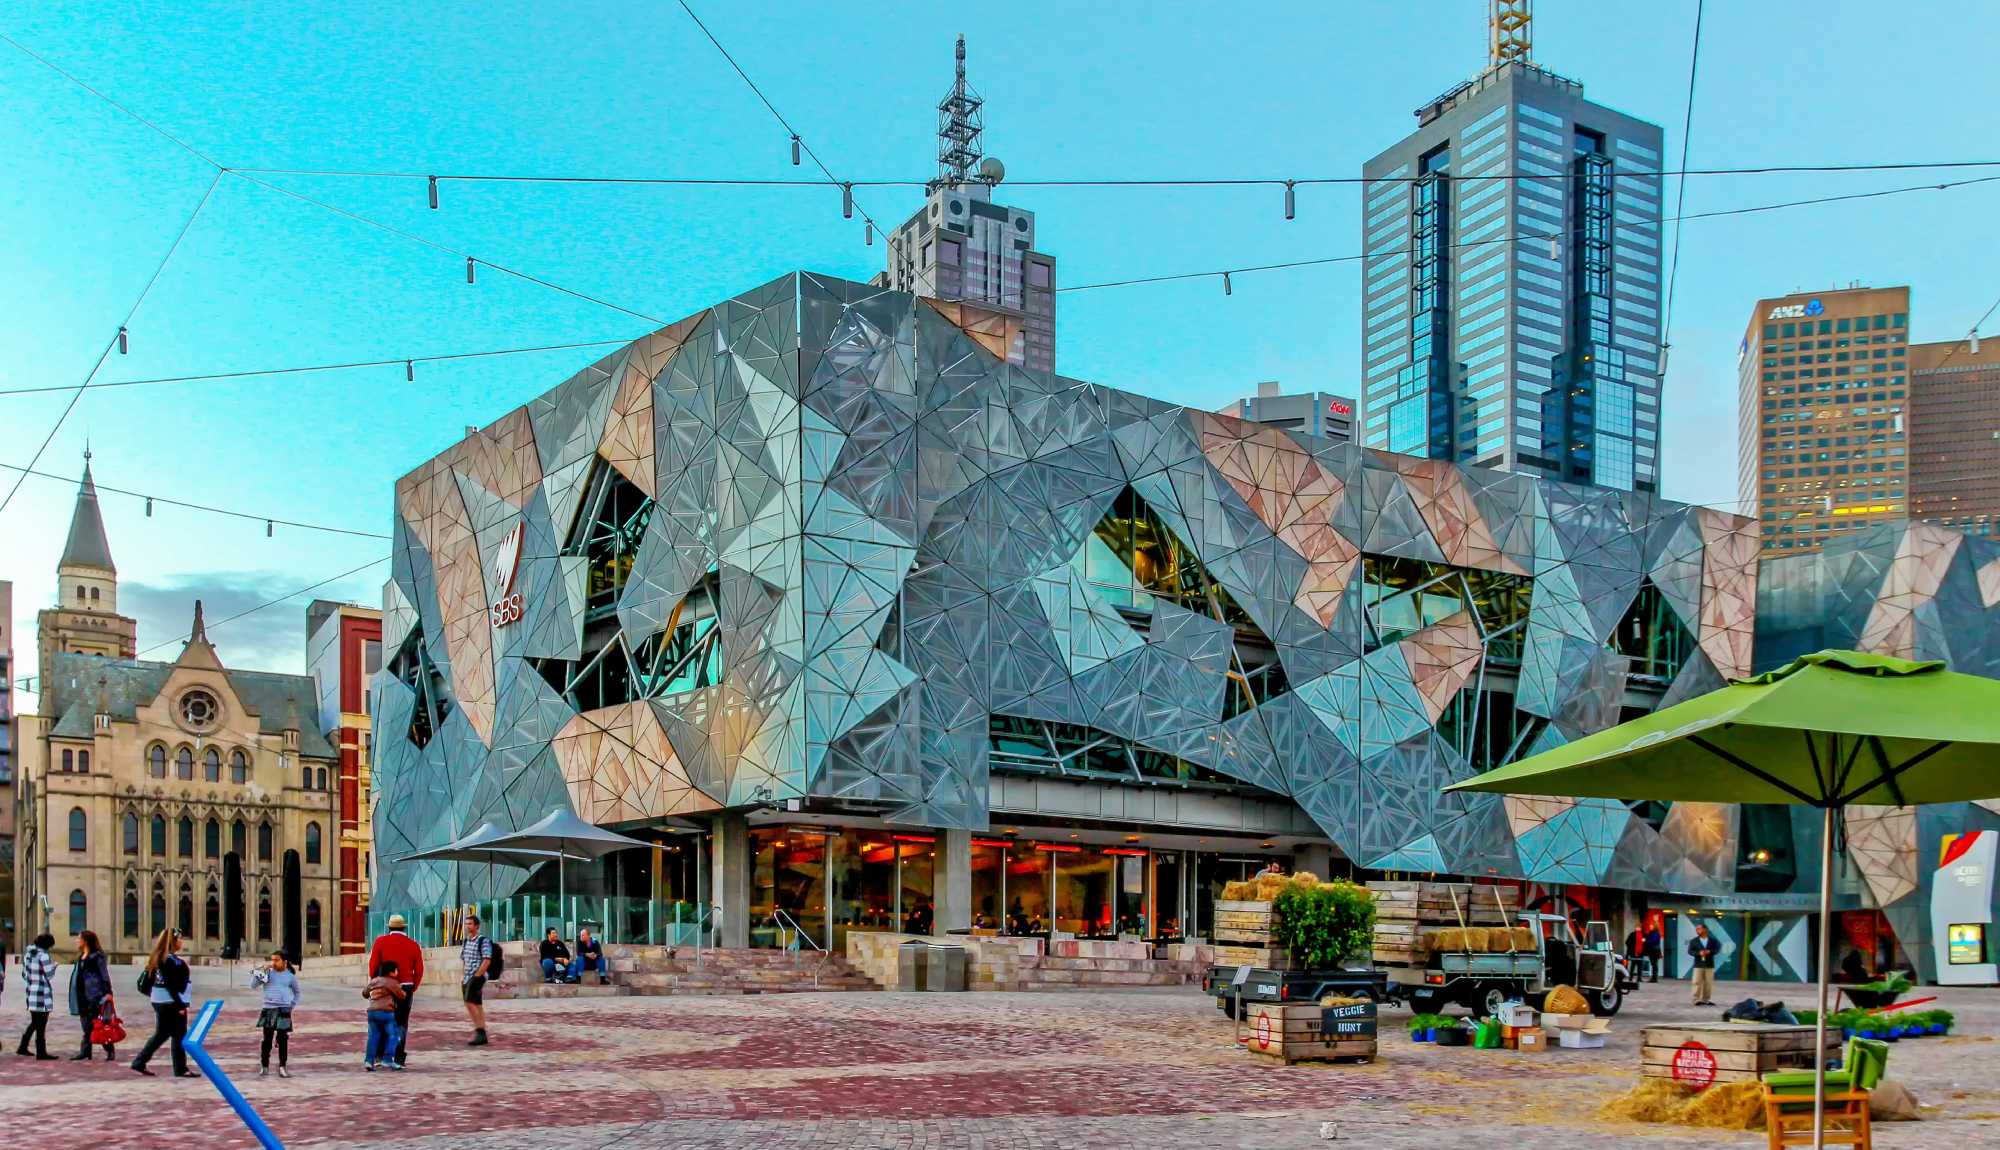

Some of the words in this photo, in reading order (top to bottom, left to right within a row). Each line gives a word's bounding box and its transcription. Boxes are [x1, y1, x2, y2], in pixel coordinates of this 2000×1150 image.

[1768, 304, 1805, 319] ANZ
[1329, 401, 1351, 415] AON
[493, 594, 521, 627] SBS
[1333, 1005, 1365, 1017] VEGGIE
[1338, 1023, 1361, 1032] HUNT
